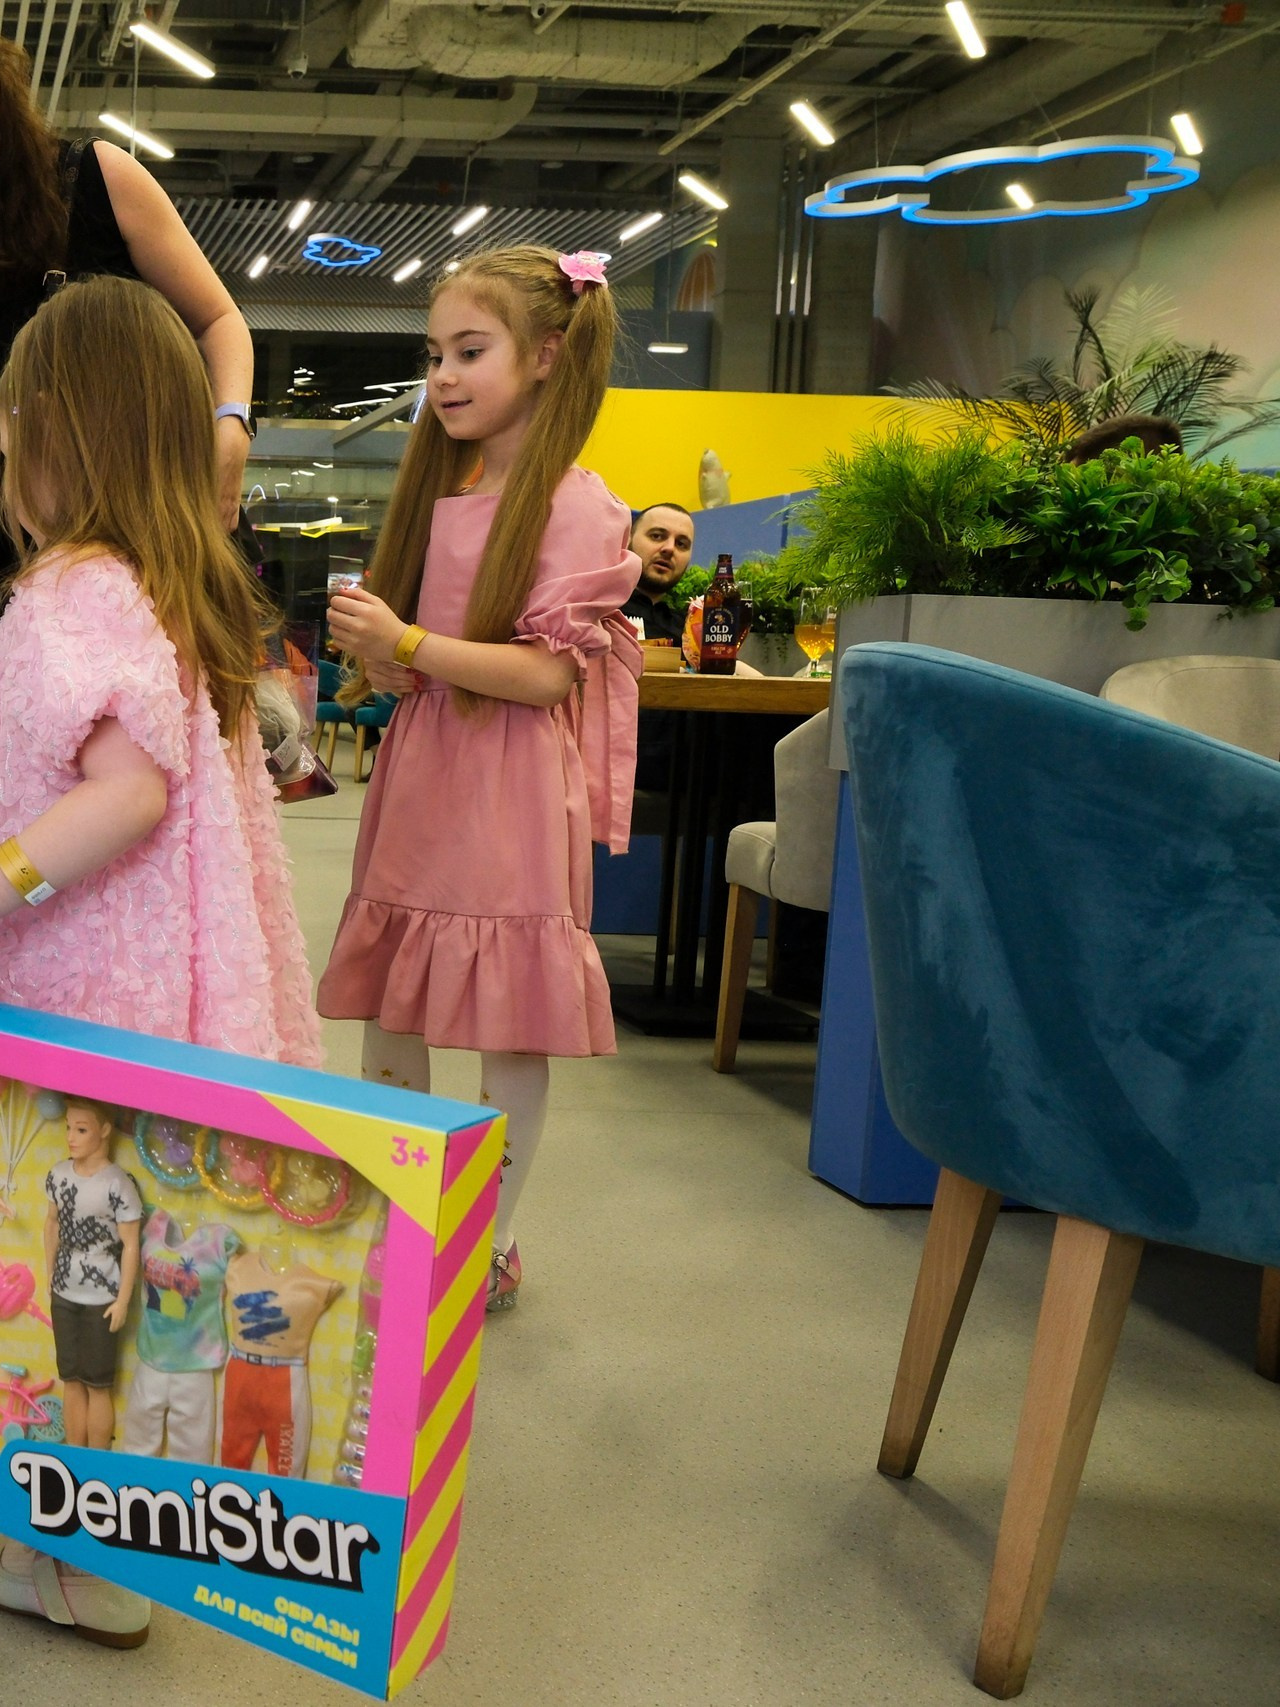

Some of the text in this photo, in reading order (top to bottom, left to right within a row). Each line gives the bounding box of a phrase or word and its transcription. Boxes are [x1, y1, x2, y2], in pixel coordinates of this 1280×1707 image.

[705, 634, 733, 643] BOBBY
[710, 624, 729, 634] OLD
[391, 1135, 431, 1168] 3+
[9, 1451, 376, 1589] DemiStar
[193, 1584, 358, 1669] ДЛЯ ВСЕЙ СЕМЬИ
[274, 1595, 361, 1647] ОБРАЗЫ
